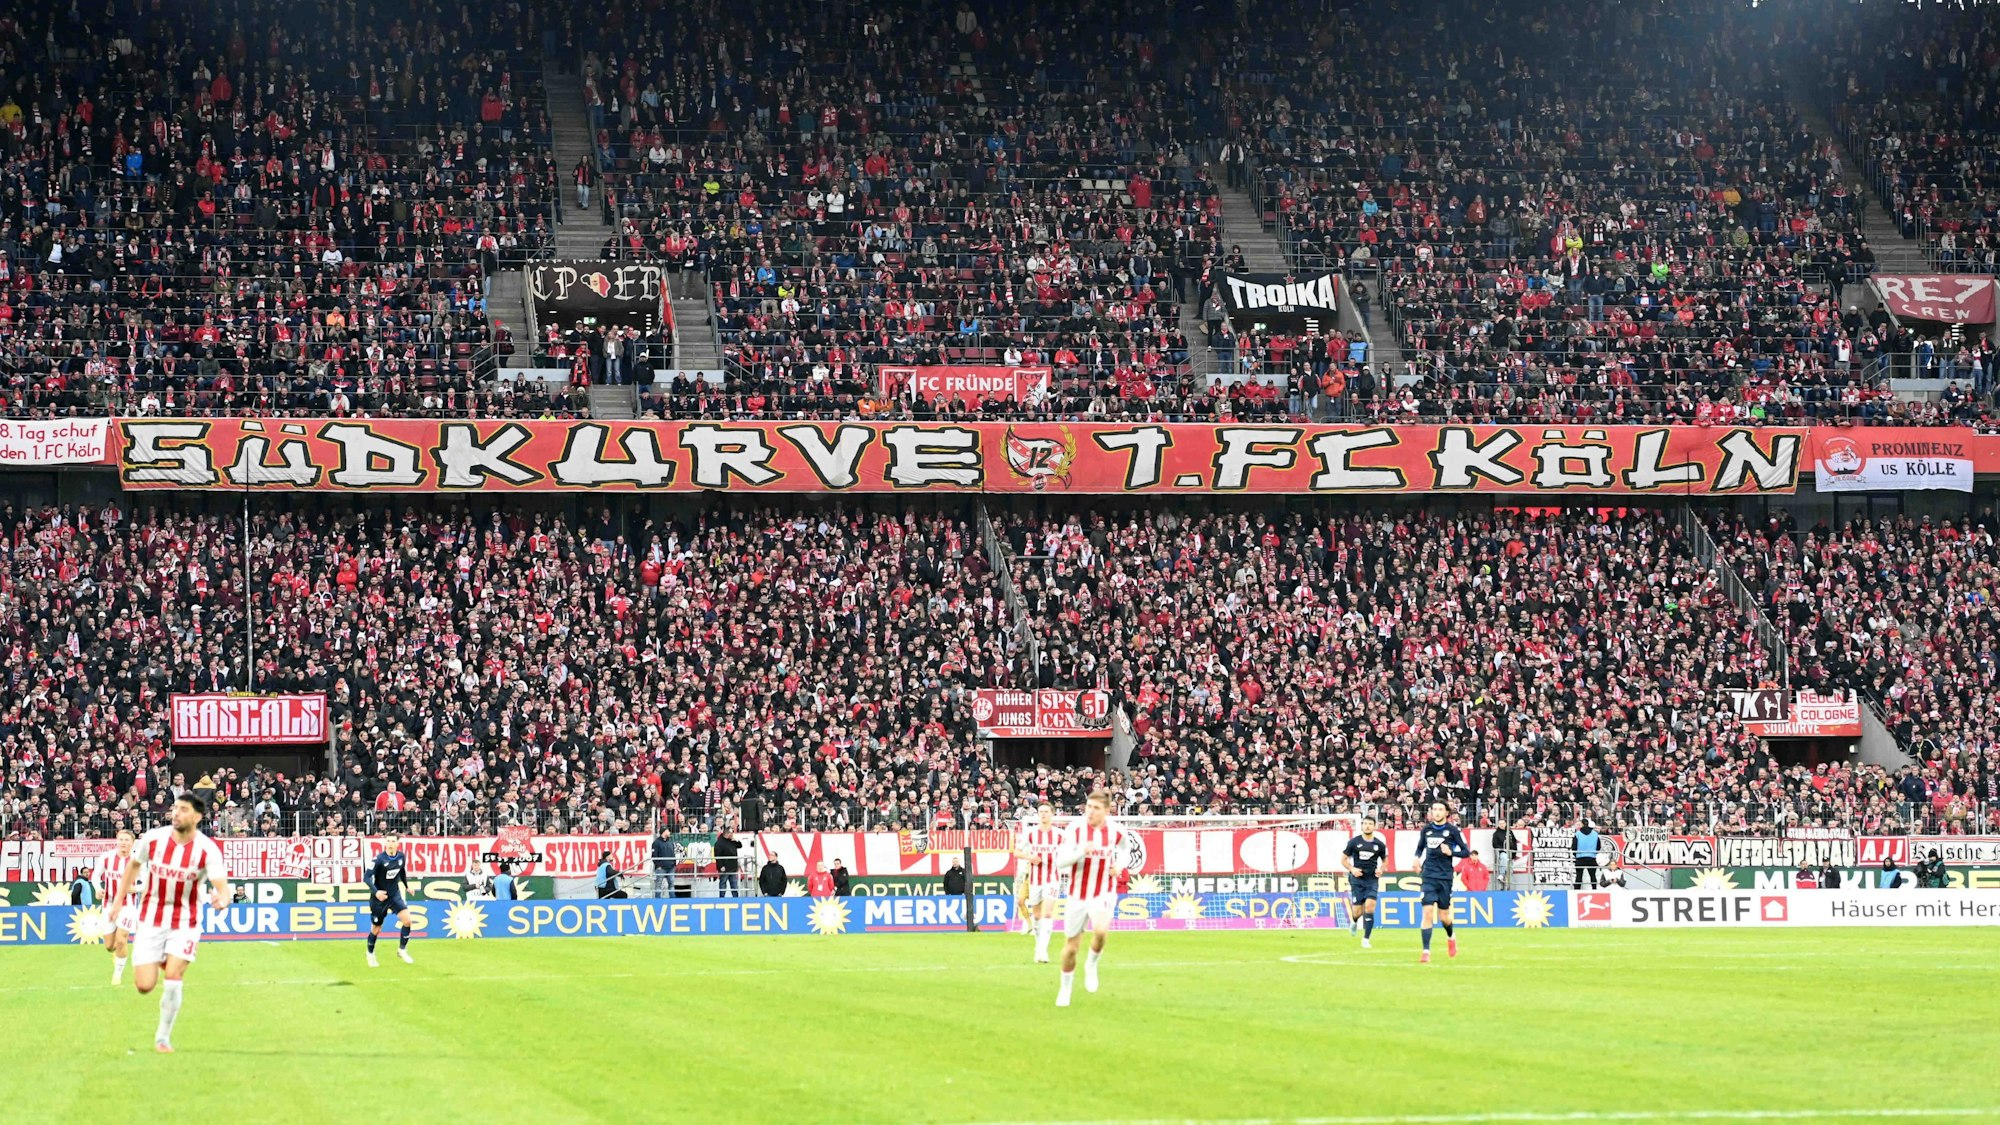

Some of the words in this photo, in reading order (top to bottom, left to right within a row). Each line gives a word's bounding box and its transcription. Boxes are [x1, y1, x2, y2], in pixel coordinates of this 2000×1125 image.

[1902, 304, 1970, 319] CREW
[919, 377, 940, 391] FC
[946, 374, 1013, 391] FRÜNDE
[17, 424, 45, 442] Tag
[52, 422, 98, 437] schuf
[0, 444, 26, 460] den
[45, 443, 64, 459] FC
[67, 442, 101, 458] Köln
[121, 420, 982, 489] SÜDKURVE
[1029, 446, 1052, 468] 12
[1871, 442, 1965, 456] PROMINENZ
[1428, 426, 1798, 492] KÖLN
[1881, 464, 1898, 475] US
[1906, 459, 1957, 476] KÖLLE
[995, 691, 1032, 706] HÖHER
[1041, 694, 1074, 709] SPS
[1731, 692, 1759, 718] TK
[178, 699, 321, 737] RASCALS
[997, 712, 1032, 726] JUNGS
[1042, 712, 1074, 728] CGN
[1800, 709, 1855, 720] COLOGNE
[1640, 833, 1655, 841] CON
[223, 840, 286, 859] SEMPER
[370, 841, 481, 874] DMSTADT
[1623, 841, 1712, 865] COLONIACS
[1862, 840, 1904, 861] AJJ
[151, 865, 185, 879] REWE
[223, 859, 280, 877] FIDELIS
[290, 905, 429, 933] BES
[507, 902, 789, 935] SPORTWETTEN
[865, 898, 1007, 925] MERKUR
[1631, 897, 1751, 922] STREIF
[1831, 900, 1907, 918] Häuser
[1916, 900, 1952, 917] mit
